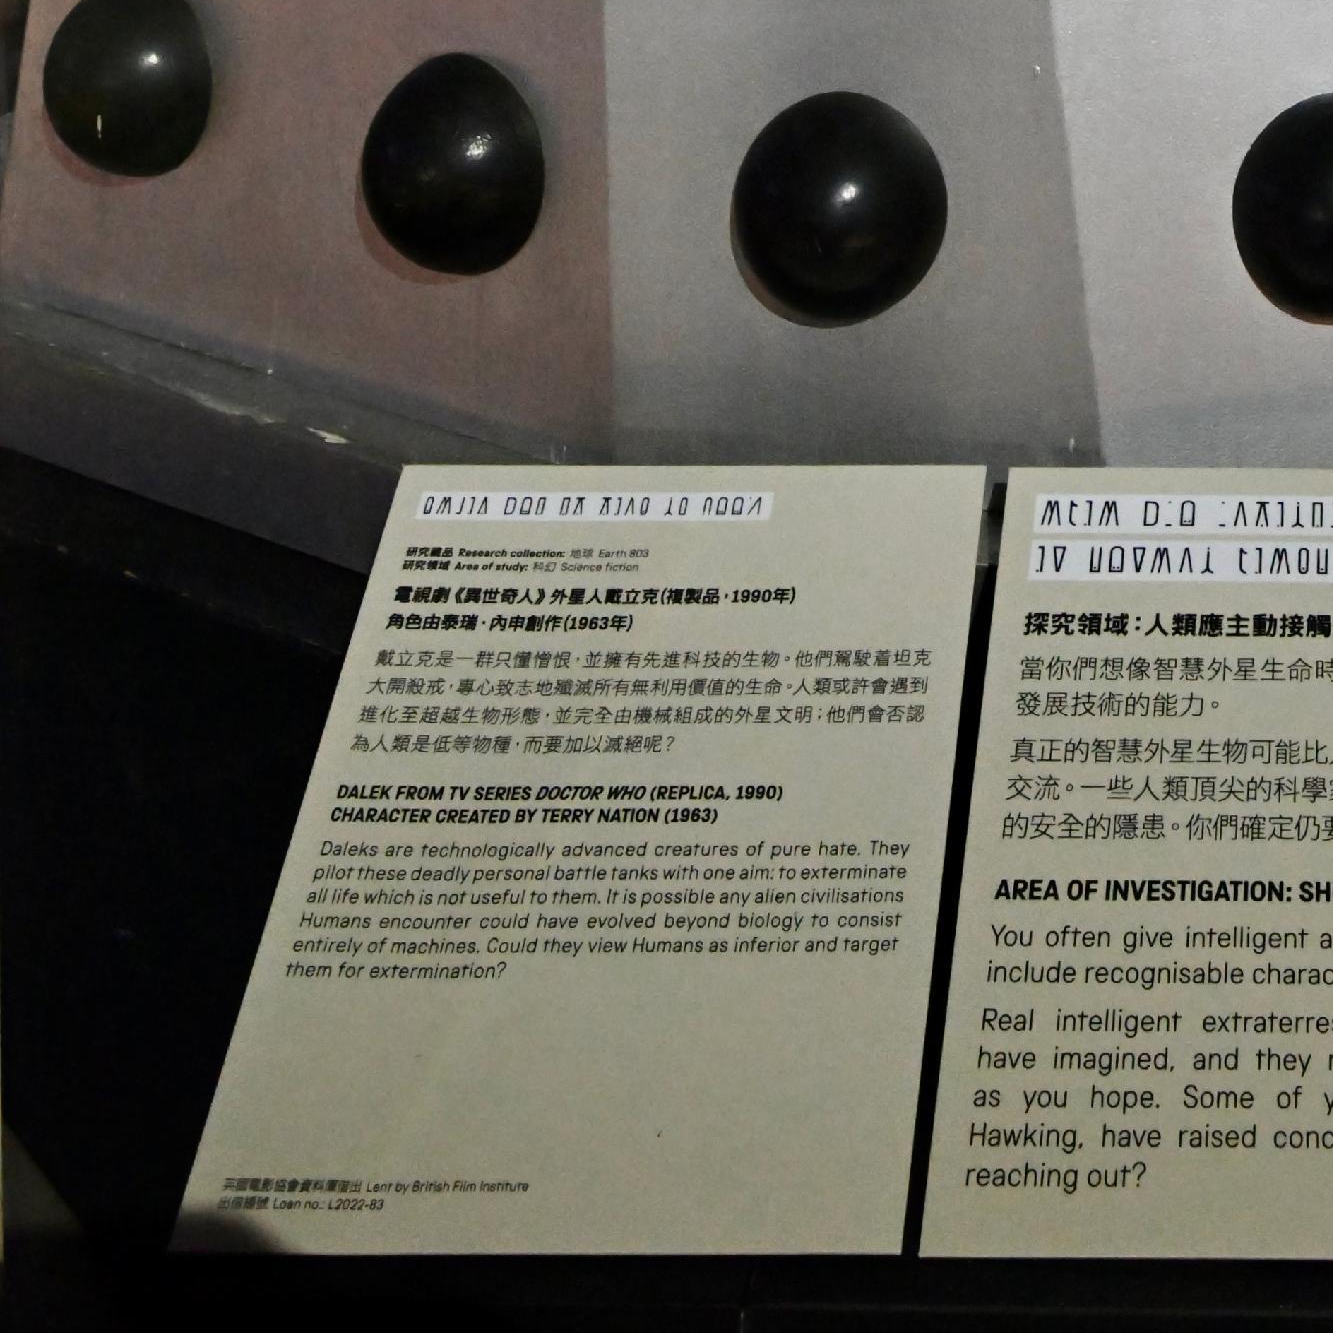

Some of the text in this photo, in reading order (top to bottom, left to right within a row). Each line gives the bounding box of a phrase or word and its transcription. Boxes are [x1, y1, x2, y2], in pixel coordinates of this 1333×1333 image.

[459, 549, 507, 557] Research
[1016, 692, 1218, 717] 發展技術的能力。
[337, 785, 782, 801] DALEK FROM TV SERIES DOCTOR WHO (REPLICA, 1990)
[330, 807, 717, 824] CHARACTER CREATED BY TERRY NATION (1963)
[321, 840, 910, 860] Daleks are technologically advanced creatures of pure hate. They
[994, 880, 1059, 900] AREA
[1067, 880, 1098, 901] OF
[1105, 880, 1291, 902] INVESTIGATION:
[300, 912, 902, 932] Humans encounter could have evolved beyond biology to consist
[293, 937, 899, 957] entirely of machines. Could they view Humans as inferior and target
[992, 925, 1033, 946] You
[1046, 925, 1110, 947] often
[1124, 926, 1173, 954] give
[1186, 926, 1309, 954] intelligent
[287, 962, 506, 978] them for extermination?
[987, 960, 1076, 983] include
[1085, 961, 1243, 990] recognisable
[982, 1008, 1033, 1031] Real
[1057, 1009, 1182, 1038] intelligent
[978, 1046, 1036, 1069] have
[1054, 1046, 1174, 1076] imagined,
[1194, 1047, 1238, 1070] and
[1256, 1048, 1311, 1077] they
[974, 1090, 1000, 1107] as
[1024, 1091, 1067, 1114] you
[1091, 1085, 1159, 1114] hope.
[1184, 1085, 1254, 1109] Some
[1277, 1086, 1302, 1109] of
[970, 1123, 1082, 1154] Hawking,
[1102, 1123, 1161, 1147] have
[1179, 1124, 1256, 1148] raised
[965, 1161, 1146, 1194] reaching out?
